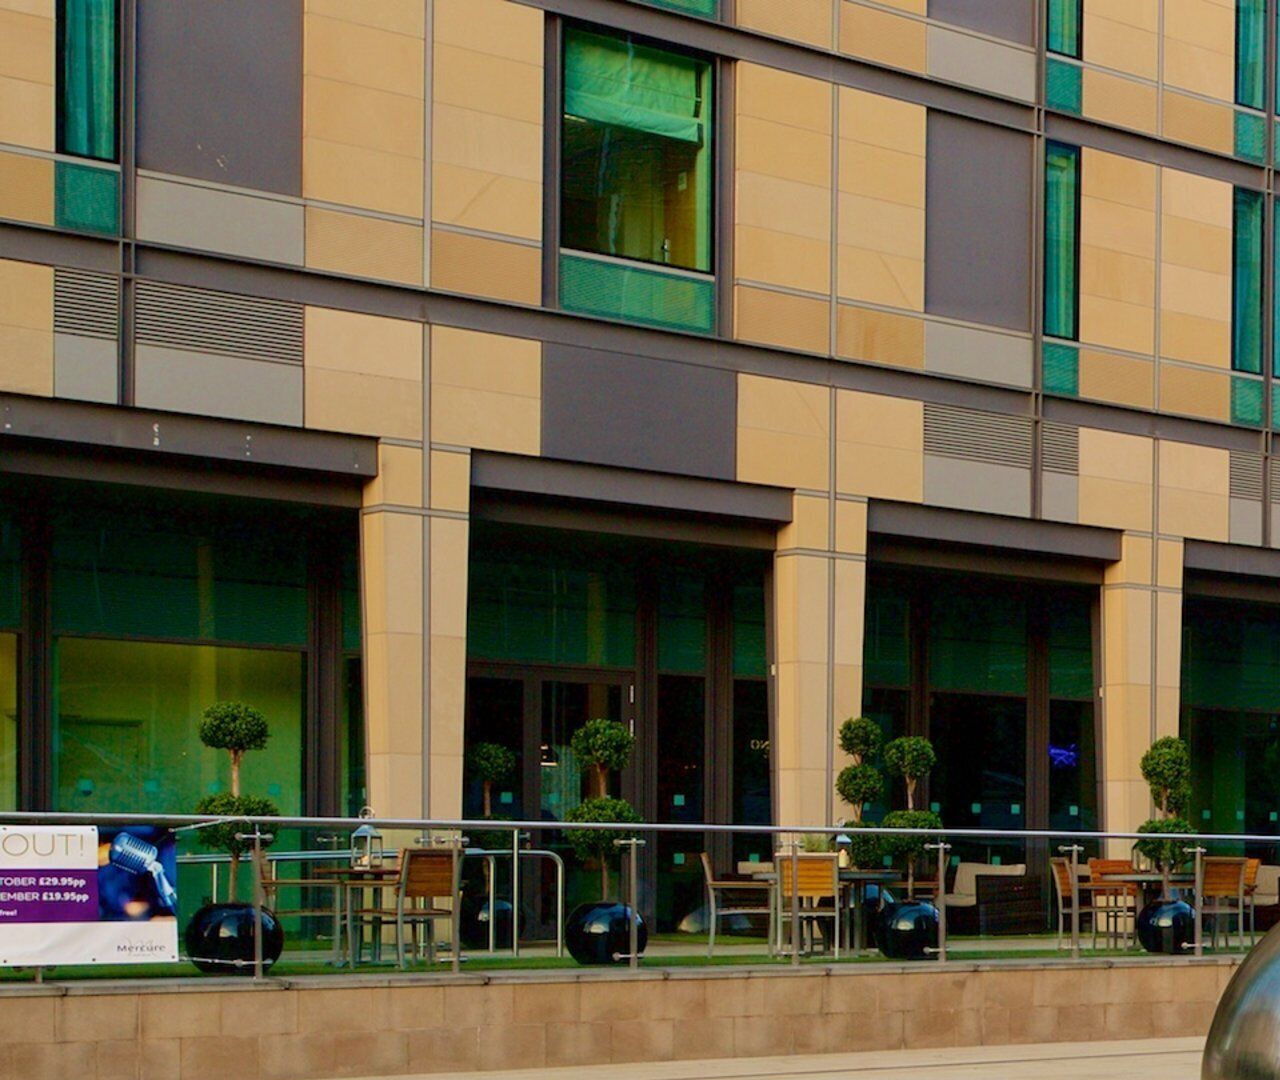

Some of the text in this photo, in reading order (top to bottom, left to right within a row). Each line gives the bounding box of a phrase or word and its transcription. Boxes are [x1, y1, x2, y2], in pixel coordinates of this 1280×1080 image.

[2, 833, 84, 857] OUT!
[39, 877, 86, 888] £29.95pp
[42, 891, 89, 903] £19.95pp
[117, 944, 166, 953] Mercure
